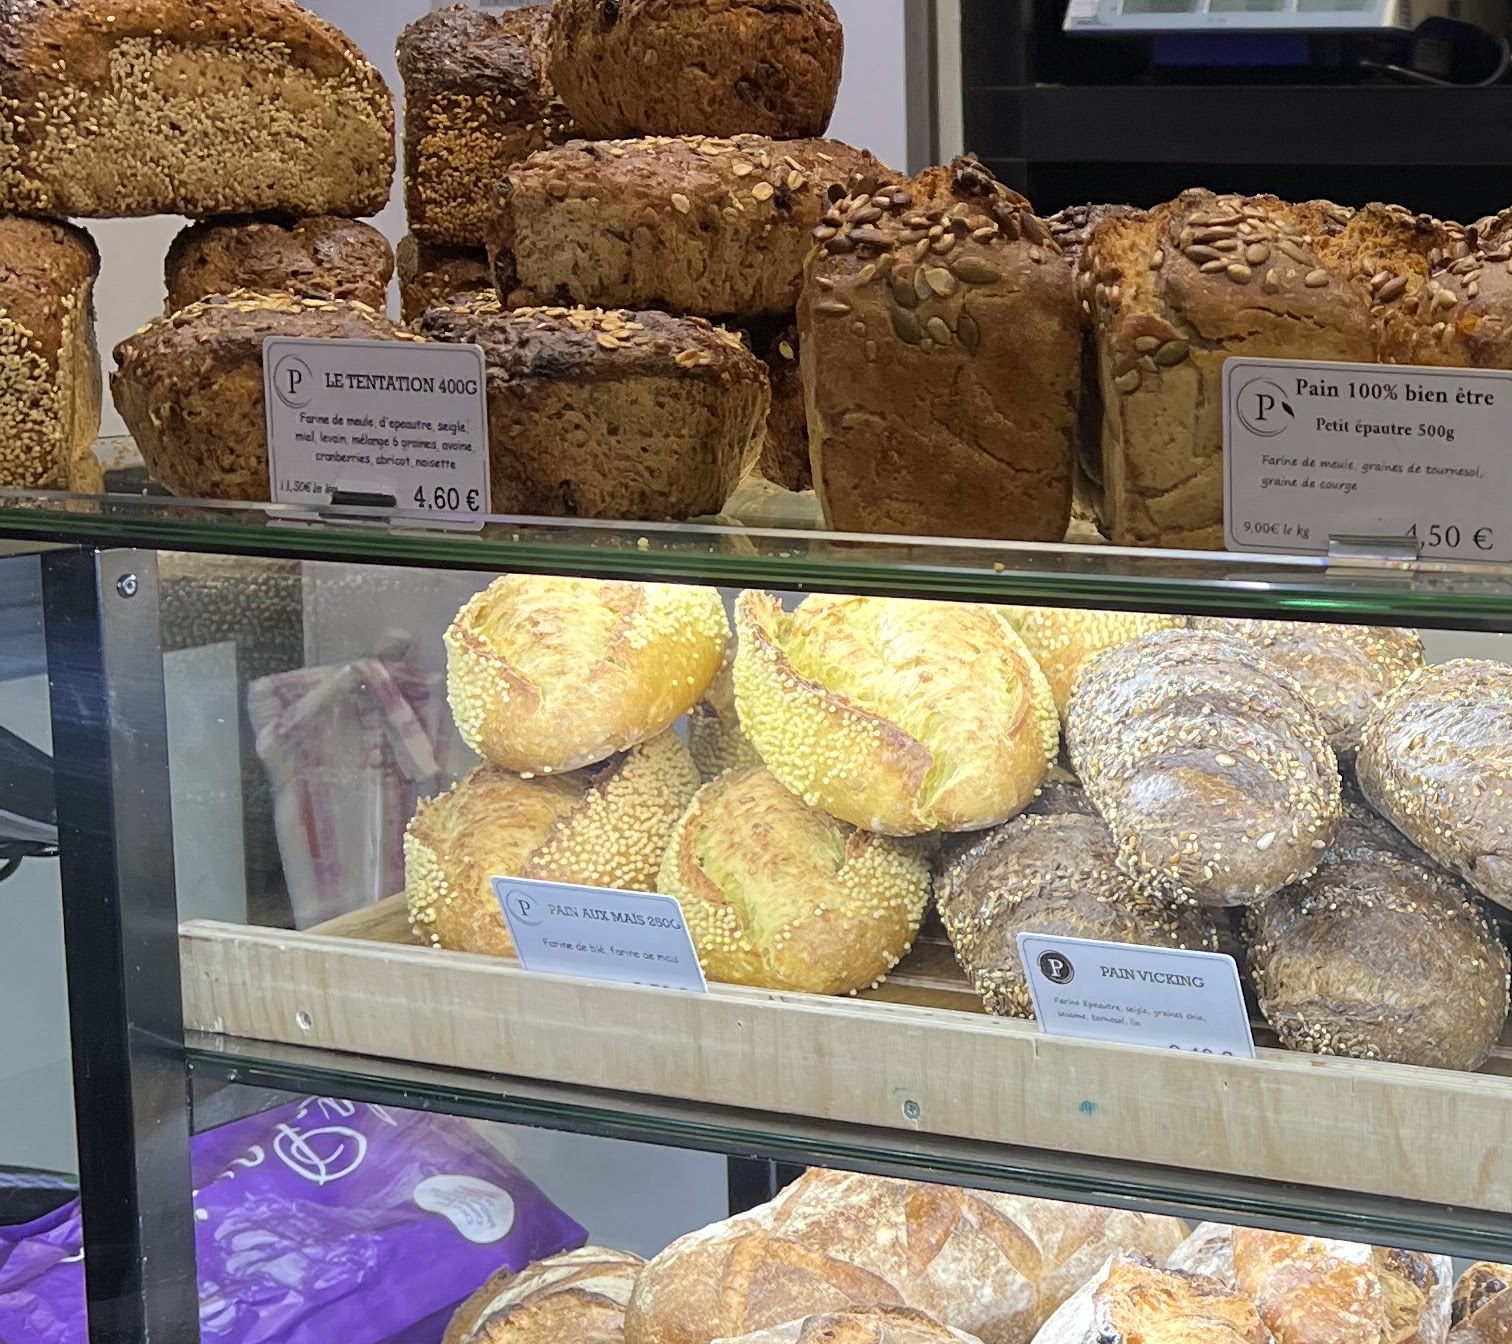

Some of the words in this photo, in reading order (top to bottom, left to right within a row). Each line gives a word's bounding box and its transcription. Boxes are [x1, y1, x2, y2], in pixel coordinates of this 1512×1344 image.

[287, 369, 302, 394] P
[325, 373, 344, 388] LE
[346, 374, 434, 393] TENTATION
[438, 378, 477, 394] 400G
[1296, 378, 1339, 398] Pain
[1348, 382, 1398, 401] 100%
[1406, 384, 1448, 404] bien
[1456, 387, 1494, 406] être
[1255, 394, 1274, 421] P
[300, 413, 329, 425] Farine
[333, 414, 343, 425] de
[1316, 418, 1349, 433] Petit
[1355, 420, 1412, 437] épautre
[1418, 423, 1455, 441] 500g
[416, 458, 456, 469] noisette
[1262, 455, 1298, 467] Farine
[1302, 456, 1316, 468] de
[1361, 461, 1403, 475] graines
[1408, 462, 1421, 474] de
[1261, 477, 1297, 489] graine
[1302, 477, 1316, 489] de
[1320, 480, 1358, 493] courge
[466, 488, 480, 511] €
[1283, 523, 1293, 535] le
[1297, 524, 1310, 539] kg
[1472, 526, 1494, 550] €
[516, 899, 530, 916] P
[548, 904, 579, 918] PAIN
[582, 908, 610, 922] AUX
[1047, 958, 1063, 977] P
[1100, 966, 1135, 981] PAIN
[1135, 970, 1204, 988] VICKING
